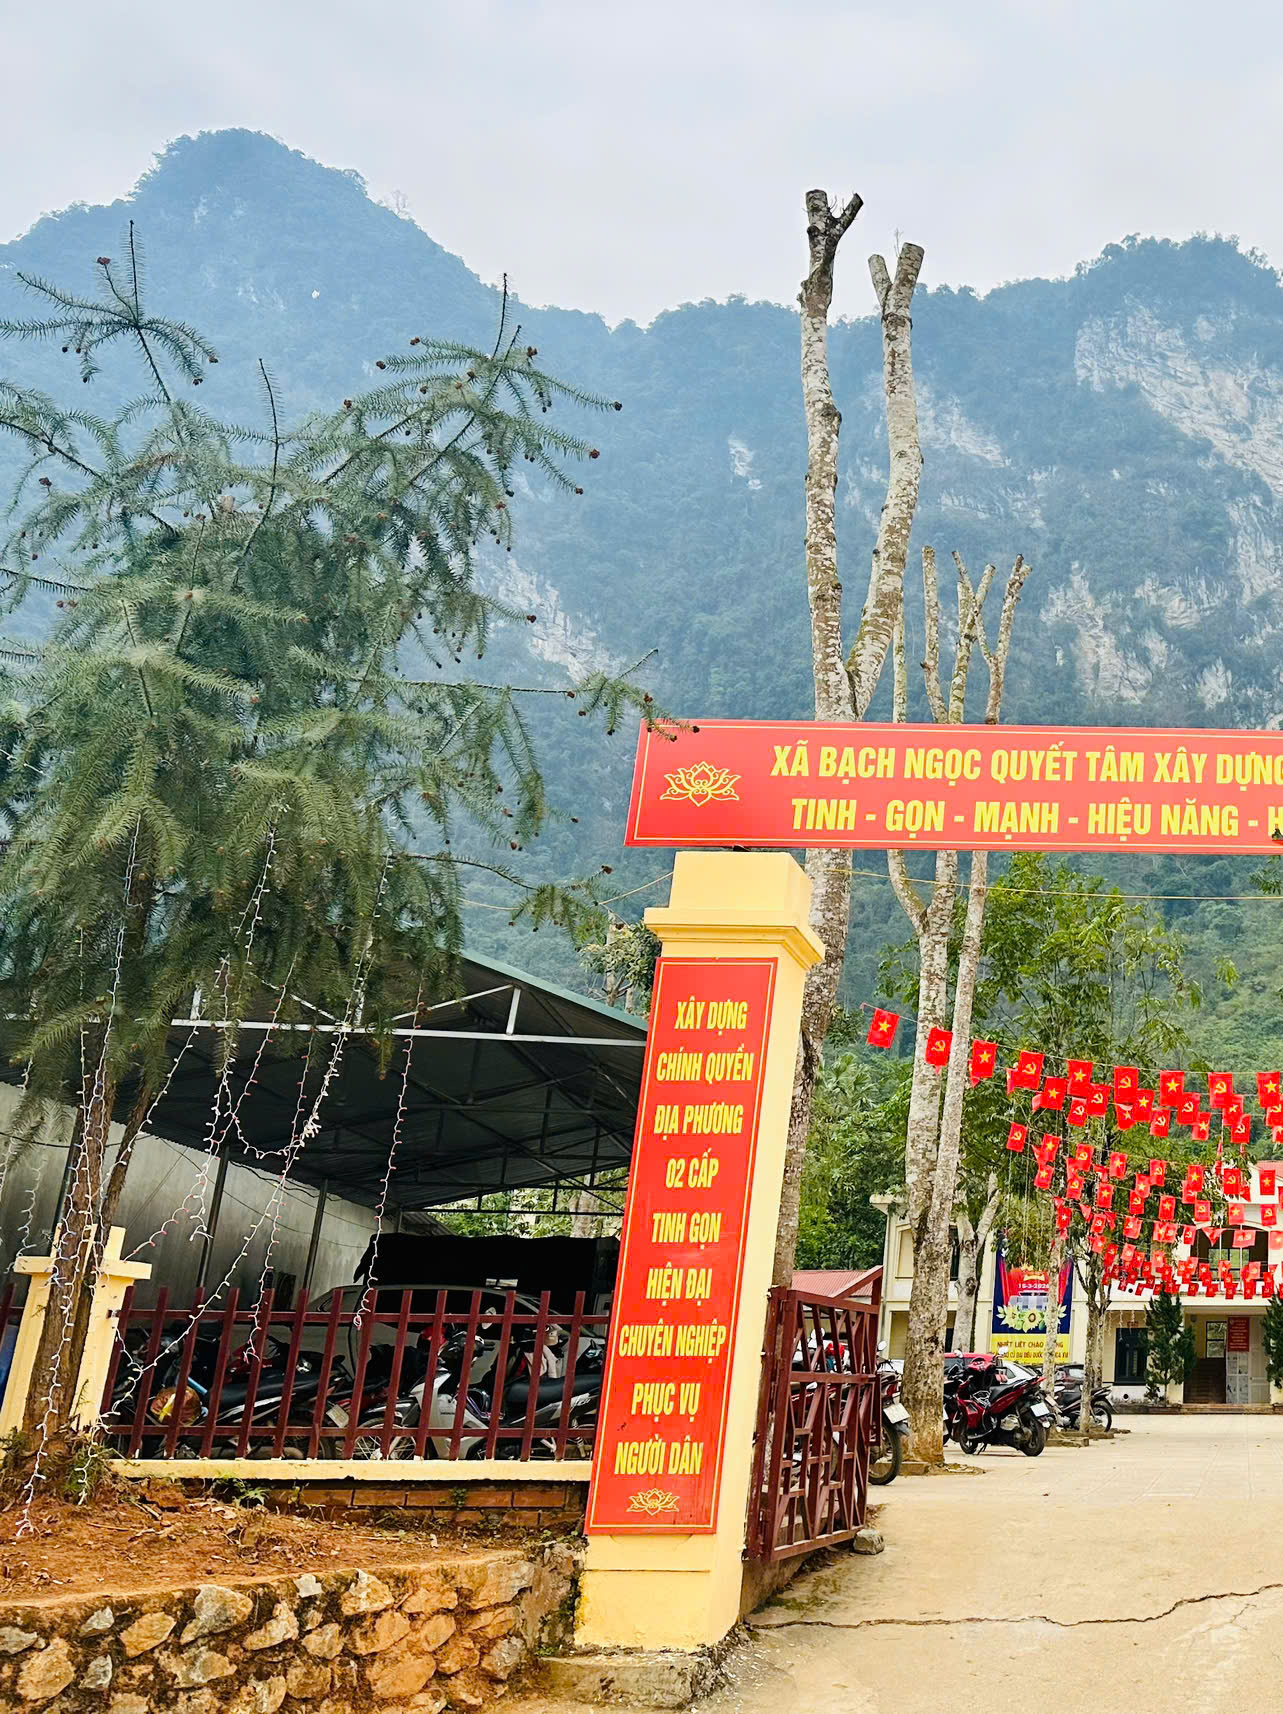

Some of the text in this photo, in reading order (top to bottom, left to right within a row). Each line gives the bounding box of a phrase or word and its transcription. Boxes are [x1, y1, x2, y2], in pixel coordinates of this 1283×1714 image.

[771, 740, 809, 777] XÃ
[819, 746, 894, 785] BẠCH
[904, 747, 981, 787] NGỌC
[991, 740, 1077, 783] QUYẾT
[1086, 745, 1144, 783] TÂM
[1153, 747, 1207, 784] XÂY
[792, 798, 856, 831] TINH
[886, 799, 944, 838] GỌN
[973, 801, 1059, 840] MẠNH
[1087, 797, 1150, 841] HIỆU
[1159, 799, 1239, 837] NĂNG
[674, 996, 748, 1035] XÂY DỰNG
[656, 1043, 754, 1085] CHÍNH QUYỀN
[654, 1101, 743, 1140] ĐỊA PHƯƠNG
[666, 1148, 719, 1188] 02 CẤP
[651, 1212, 722, 1250] TINH GỌN
[646, 1262, 712, 1306] HIỆN ĐẠI
[619, 1319, 727, 1364] CHUYÊN NGHIỆP
[631, 1383, 700, 1422] PHỤC VỤ
[614, 1434, 704, 1474] NGƯỜI DÂN
